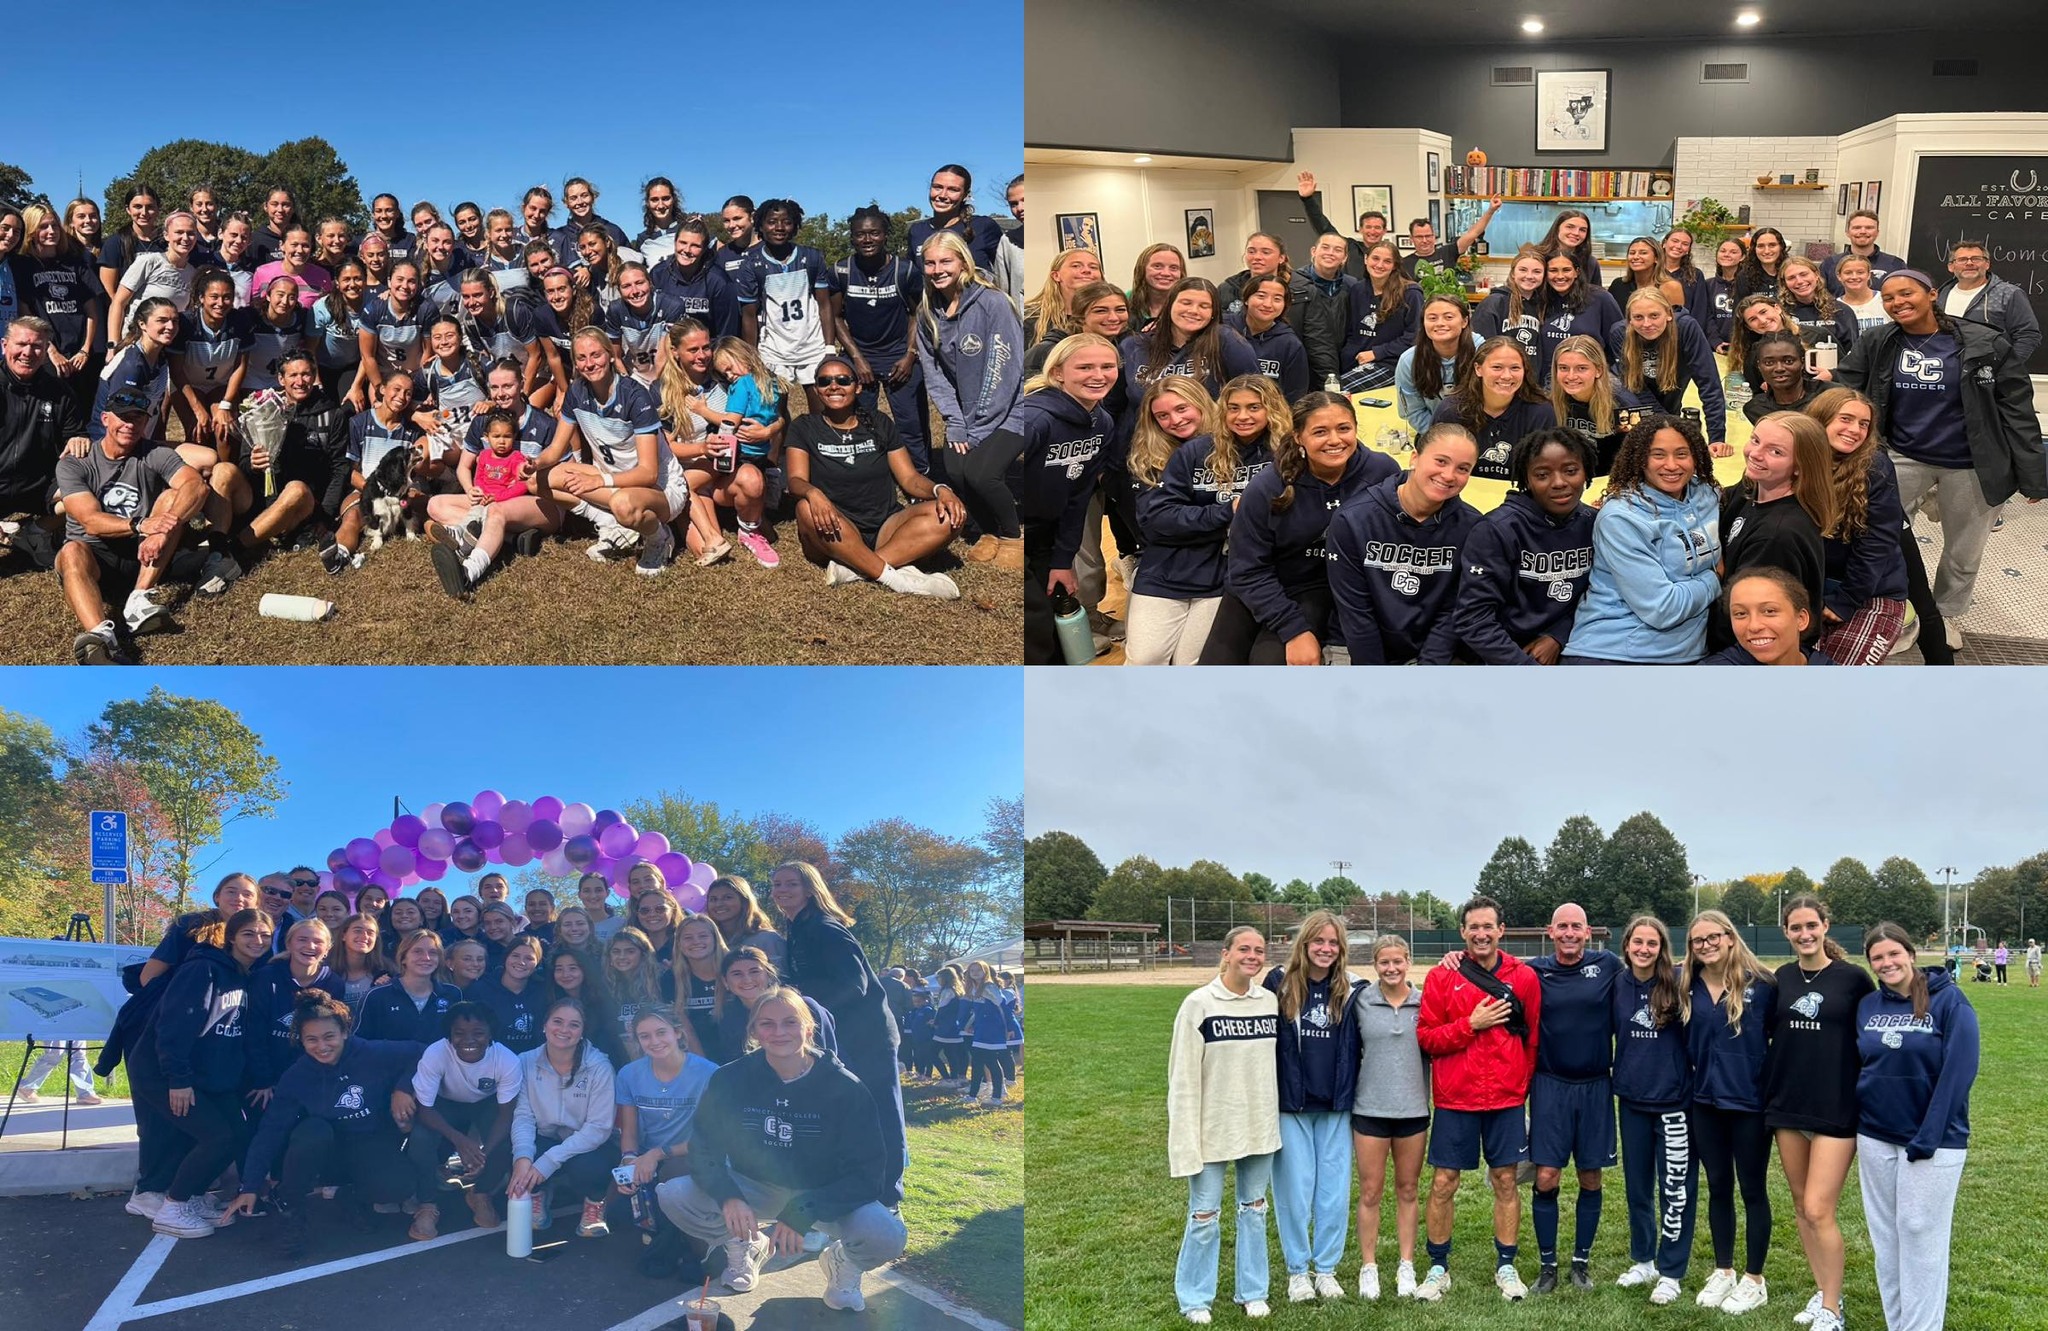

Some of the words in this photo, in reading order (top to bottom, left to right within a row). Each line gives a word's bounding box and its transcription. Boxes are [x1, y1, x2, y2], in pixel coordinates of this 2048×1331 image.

[1940, 195, 1981, 207] ALL
[33, 271, 78, 288] CONNECTICUT
[45, 300, 78, 314] COLLEGE
[781, 299, 804, 322] 13
[991, 333, 1012, 391] Killington
[1899, 348, 1944, 383] CC
[205, 366, 218, 380] 7
[1895, 382, 1946, 391] SOCCER
[1479, 466, 1509, 475] SOCCER
[1366, 540, 1457, 567] SOCCER
[1391, 570, 1421, 596] CC
[1547, 579, 1573, 602] CC
[1301, 1029, 1330, 1038] SOCCER
[1789, 1020, 1822, 1030] SOCCER
[1630, 1030, 1659, 1039] SOCCER
[764, 1115, 793, 1142] CC
[1661, 1111, 1689, 1243] CONNECTICUT
